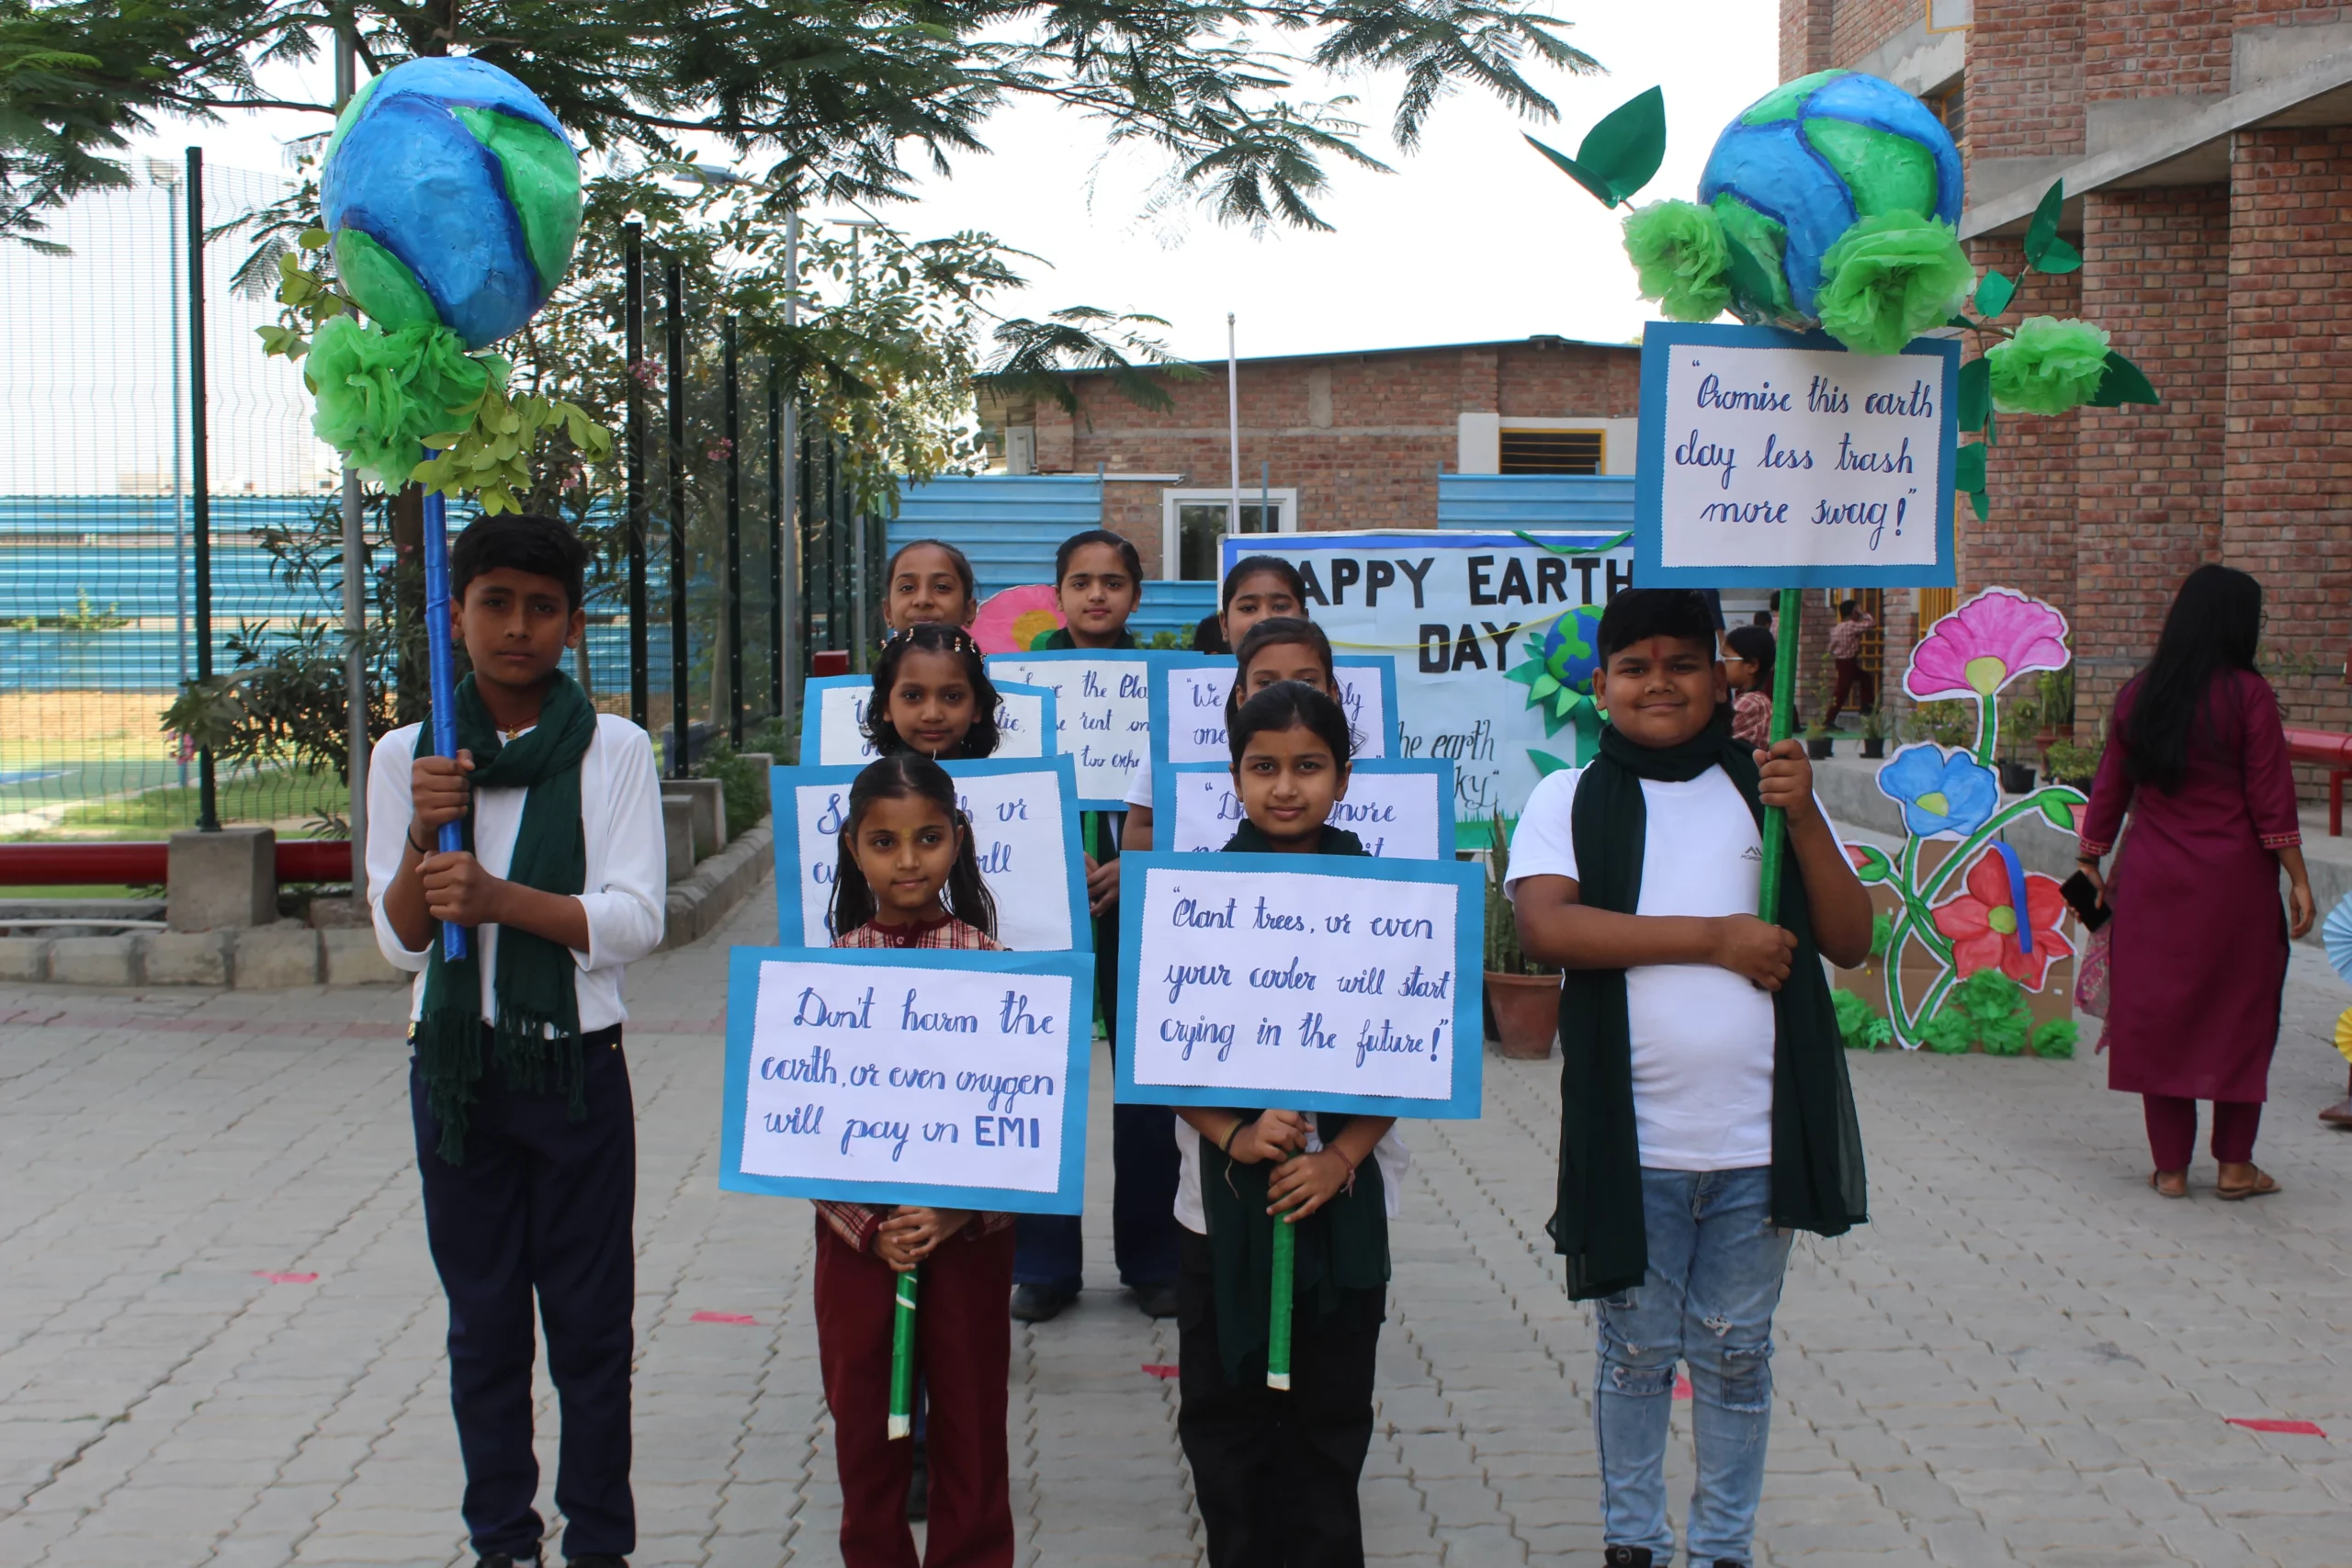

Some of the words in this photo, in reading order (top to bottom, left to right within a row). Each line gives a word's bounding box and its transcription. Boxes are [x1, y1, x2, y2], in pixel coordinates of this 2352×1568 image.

[1807, 376, 1849, 413] this
[1865, 380, 1932, 417] earth
[1676, 429, 1736, 489] day
[1757, 434, 1814, 469] less
[1835, 433, 1913, 473] trash
[1700, 499, 1789, 524] more
[1297, 557, 1435, 609] APPY
[1467, 555, 1634, 605] EARTH
[1419, 621, 1521, 673] DAY
[1082, 670, 1108, 698] the
[1080, 708, 1114, 731] rent
[1193, 728, 1227, 745] one
[1398, 721, 1422, 759] he
[1430, 719, 1494, 761] earth
[1080, 745, 1106, 767] too
[1454, 765, 1499, 809] ky"
[996, 798, 1028, 822] or
[976, 841, 1012, 874] ill
[1325, 914, 1351, 934] or
[1370, 916, 1433, 940] even
[1163, 963, 1232, 1004] your
[1250, 956, 1317, 991] cooler
[1337, 967, 1385, 995] will
[1397, 965, 1451, 999] start
[794, 987, 875, 1029] Don't
[901, 988, 978, 1033] harm
[1000, 990, 1054, 1034] the
[1257, 1017, 1282, 1046] in
[1299, 1012, 1337, 1049] the
[850, 1064, 880, 1087] or
[889, 1066, 946, 1089] even
[956, 1072, 1054, 1113] oxygen
[763, 1103, 824, 1135] will
[842, 1118, 910, 1162] pay
[922, 1121, 958, 1144] on
[975, 1115, 1040, 1149] EMI
